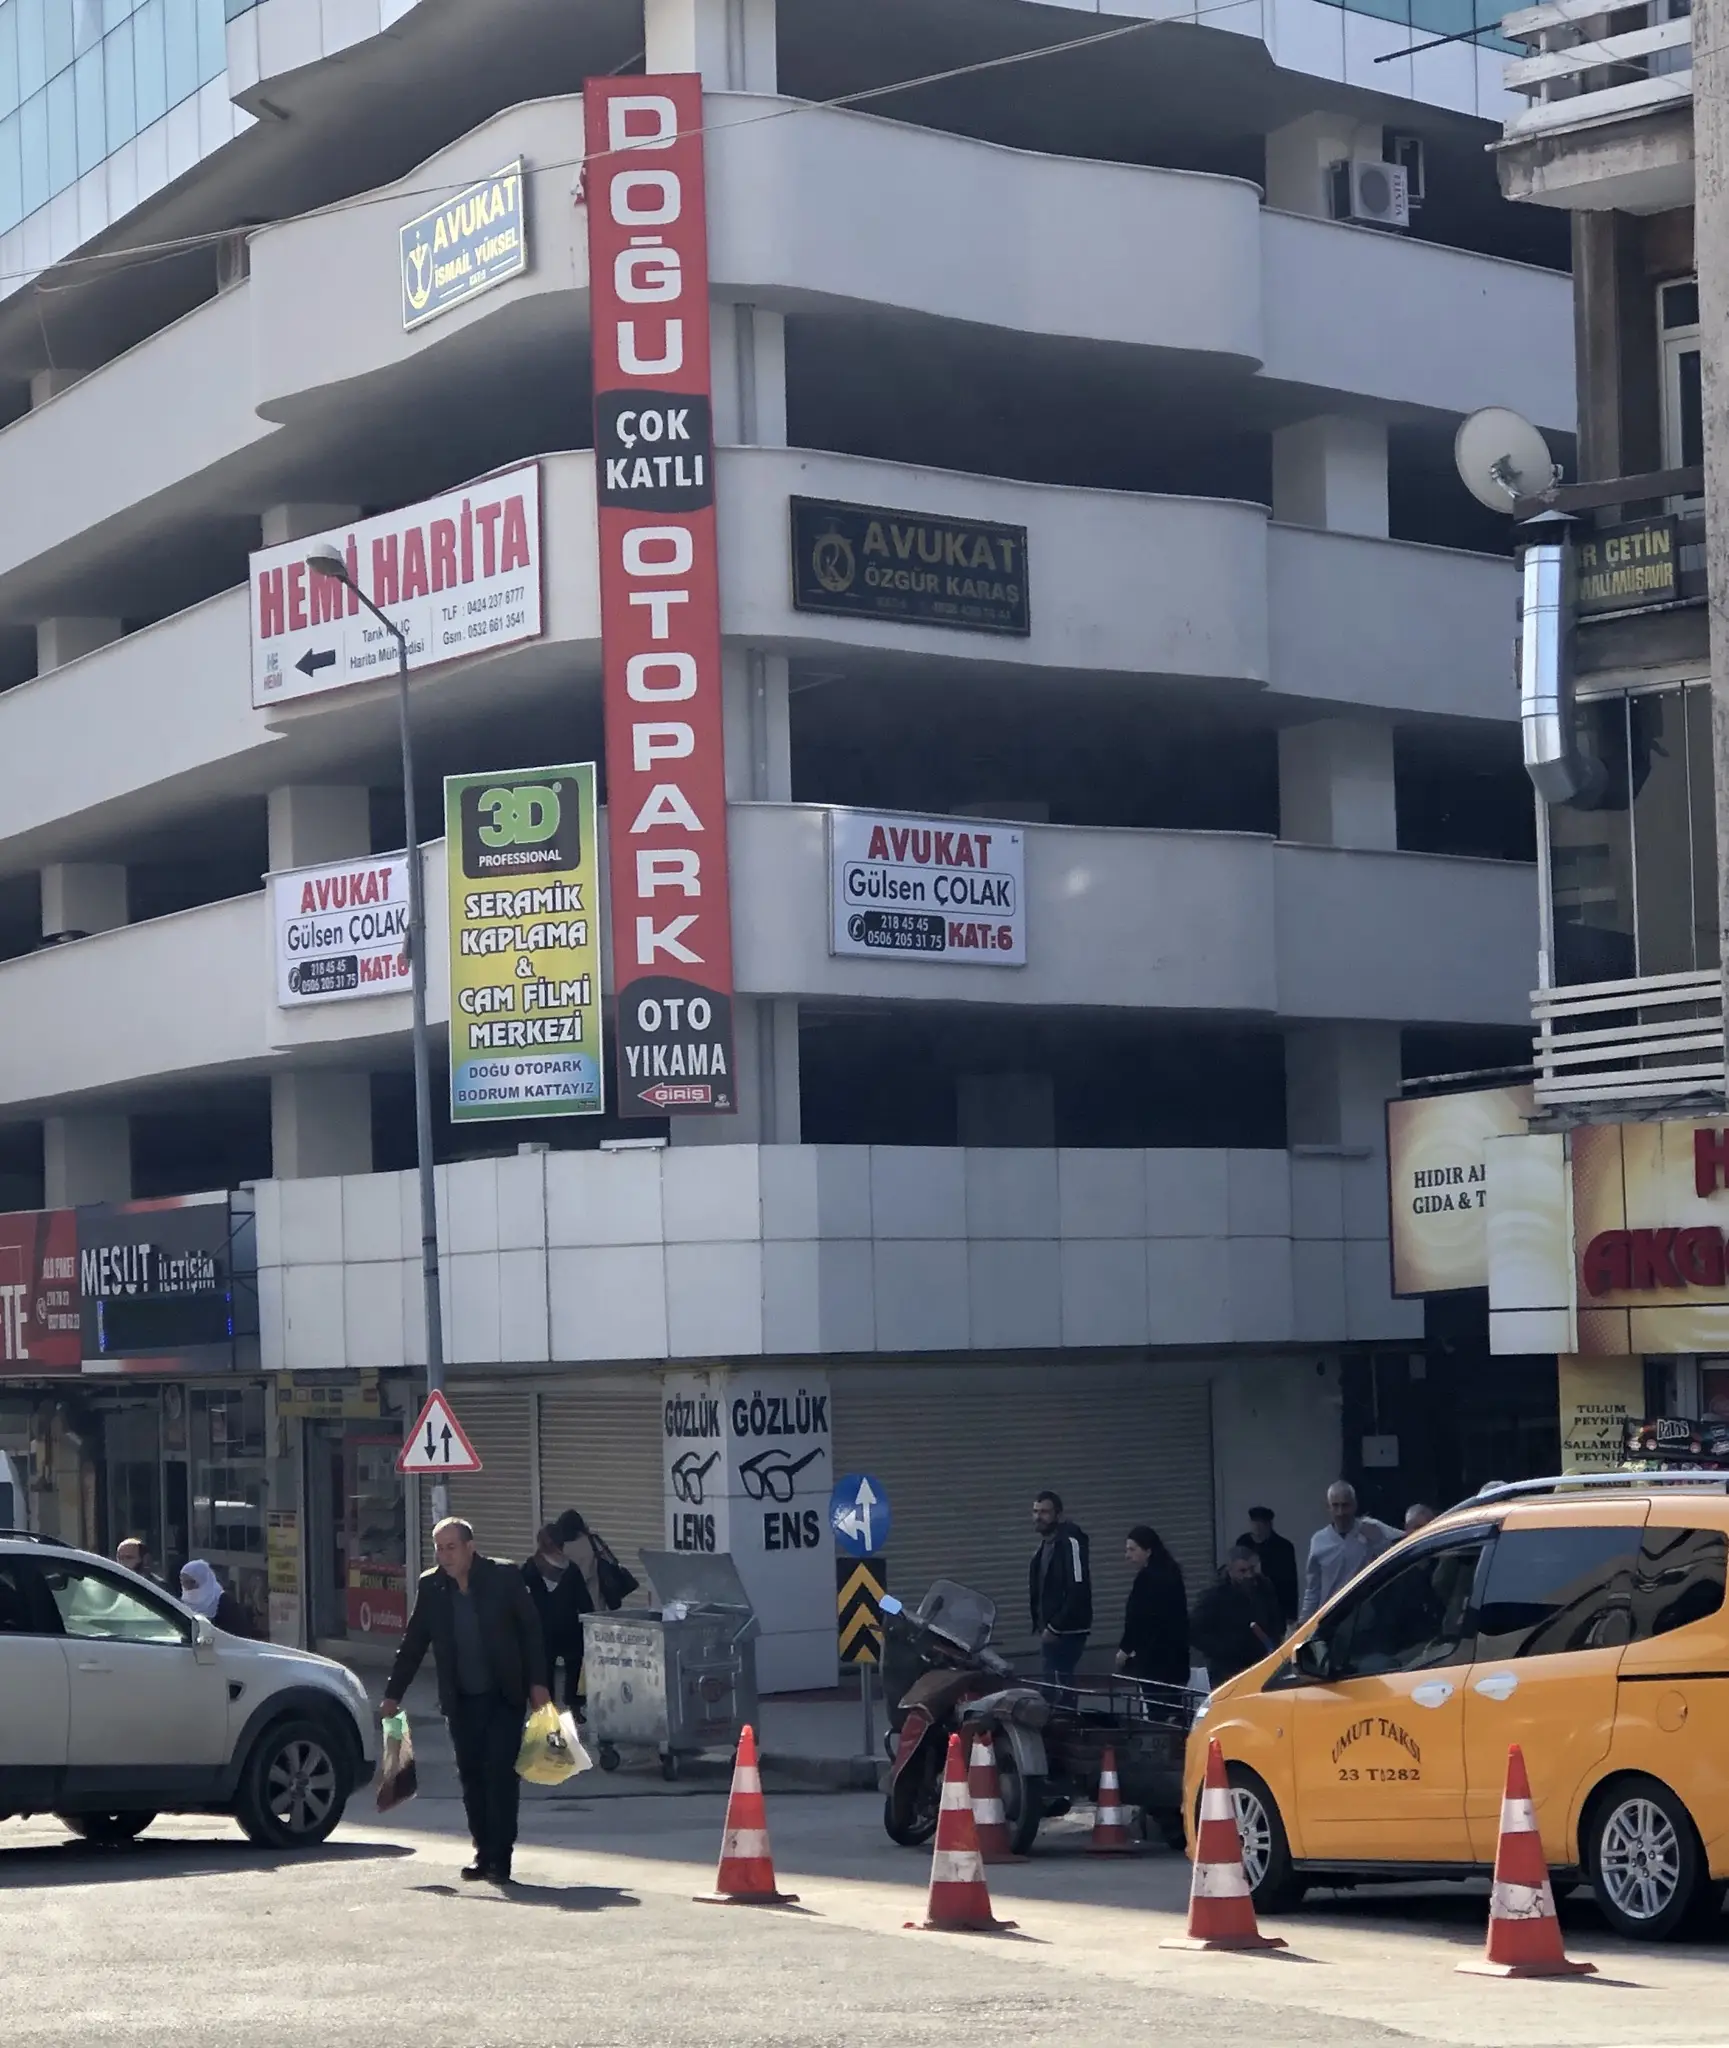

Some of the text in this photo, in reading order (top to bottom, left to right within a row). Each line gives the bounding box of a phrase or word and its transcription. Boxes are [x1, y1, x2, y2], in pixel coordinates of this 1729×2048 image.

[433, 176, 517, 253] AVUKAT
[608, 95, 683, 376] DOĞU
[435, 248, 472, 288] İSMAİL
[474, 227, 518, 266] YÜKSEL
[615, 408, 690, 449] ÇOK
[606, 454, 704, 490] KATLI
[862, 520, 1017, 574] AVUKAT
[259, 494, 530, 639] HEMİ HARİTA
[864, 561, 940, 595] ÖZGÜR
[441, 605, 457, 622] TLF
[467, 599, 487, 616] 0424
[488, 593, 503, 609] 237
[442, 631, 462, 645] Gsm
[505, 609, 525, 629] 3541
[622, 526, 705, 965] OTOPARK
[478, 785, 561, 848] 3D
[478, 849, 563, 868] PROFESSIONAL
[867, 825, 992, 869] AVUKAT
[300, 867, 392, 915] AVUKAT
[464, 880, 585, 920] SERAMİK
[848, 868, 1011, 907] Gülsen ÇOLAK
[349, 907, 408, 945] ÇOLAK
[460, 919, 589, 957] KAPLAMA
[867, 930, 943, 949] 0506 205 31 75
[881, 914, 929, 932] 218 45 45
[948, 921, 1013, 951] KAT:6
[311, 959, 346, 977] 218 45 45
[346, 973, 357, 987] 75
[514, 955, 537, 979] &
[458, 972, 592, 1017] CAM FİLMİ
[468, 1009, 584, 1050] MERKEZİ
[637, 997, 712, 1032] OTO
[469, 1059, 583, 1080] DOĞU OTOPARK
[625, 1043, 728, 1078] YIKAMA
[458, 1082, 595, 1103] BODRUM KATTAYIZ
[1414, 1166, 1464, 1189] HIDIR
[1412, 1194, 1455, 1215] GIDA
[1458, 1191, 1473, 1210] &
[81, 1244, 216, 1297] MESUT İLETİŞİM
[664, 1392, 721, 1438] GÖZLÜK
[732, 1389, 828, 1437] GÖZLÜK
[1577, 1404, 1627, 1414] TULUM
[673, 1512, 716, 1553] LENS
[763, 1509, 821, 1551] ENS
[1332, 1718, 1374, 1765] UMUT
[1338, 1768, 1360, 1781] 23
